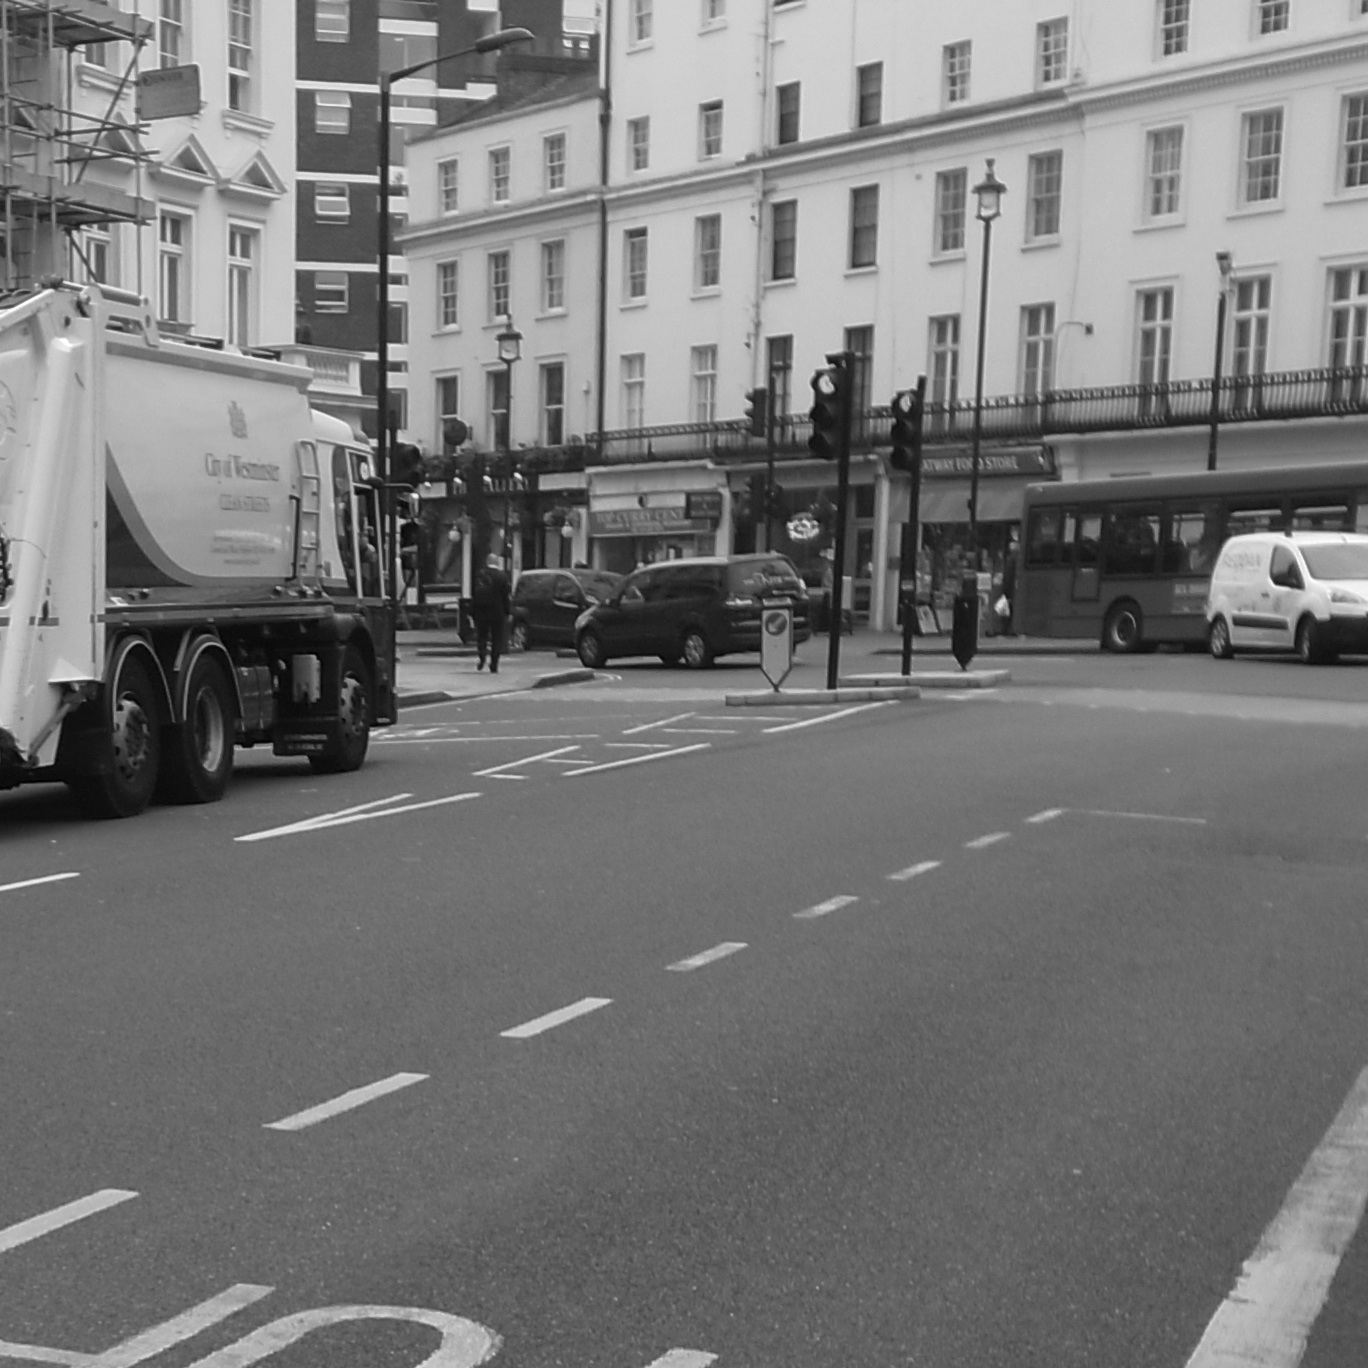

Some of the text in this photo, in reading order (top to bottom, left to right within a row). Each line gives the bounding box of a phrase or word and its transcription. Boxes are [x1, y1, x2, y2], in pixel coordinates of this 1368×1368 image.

[920, 457, 953, 473] ATWAY
[985, 454, 1019, 470] STORE
[655, 508, 685, 521] CENT
